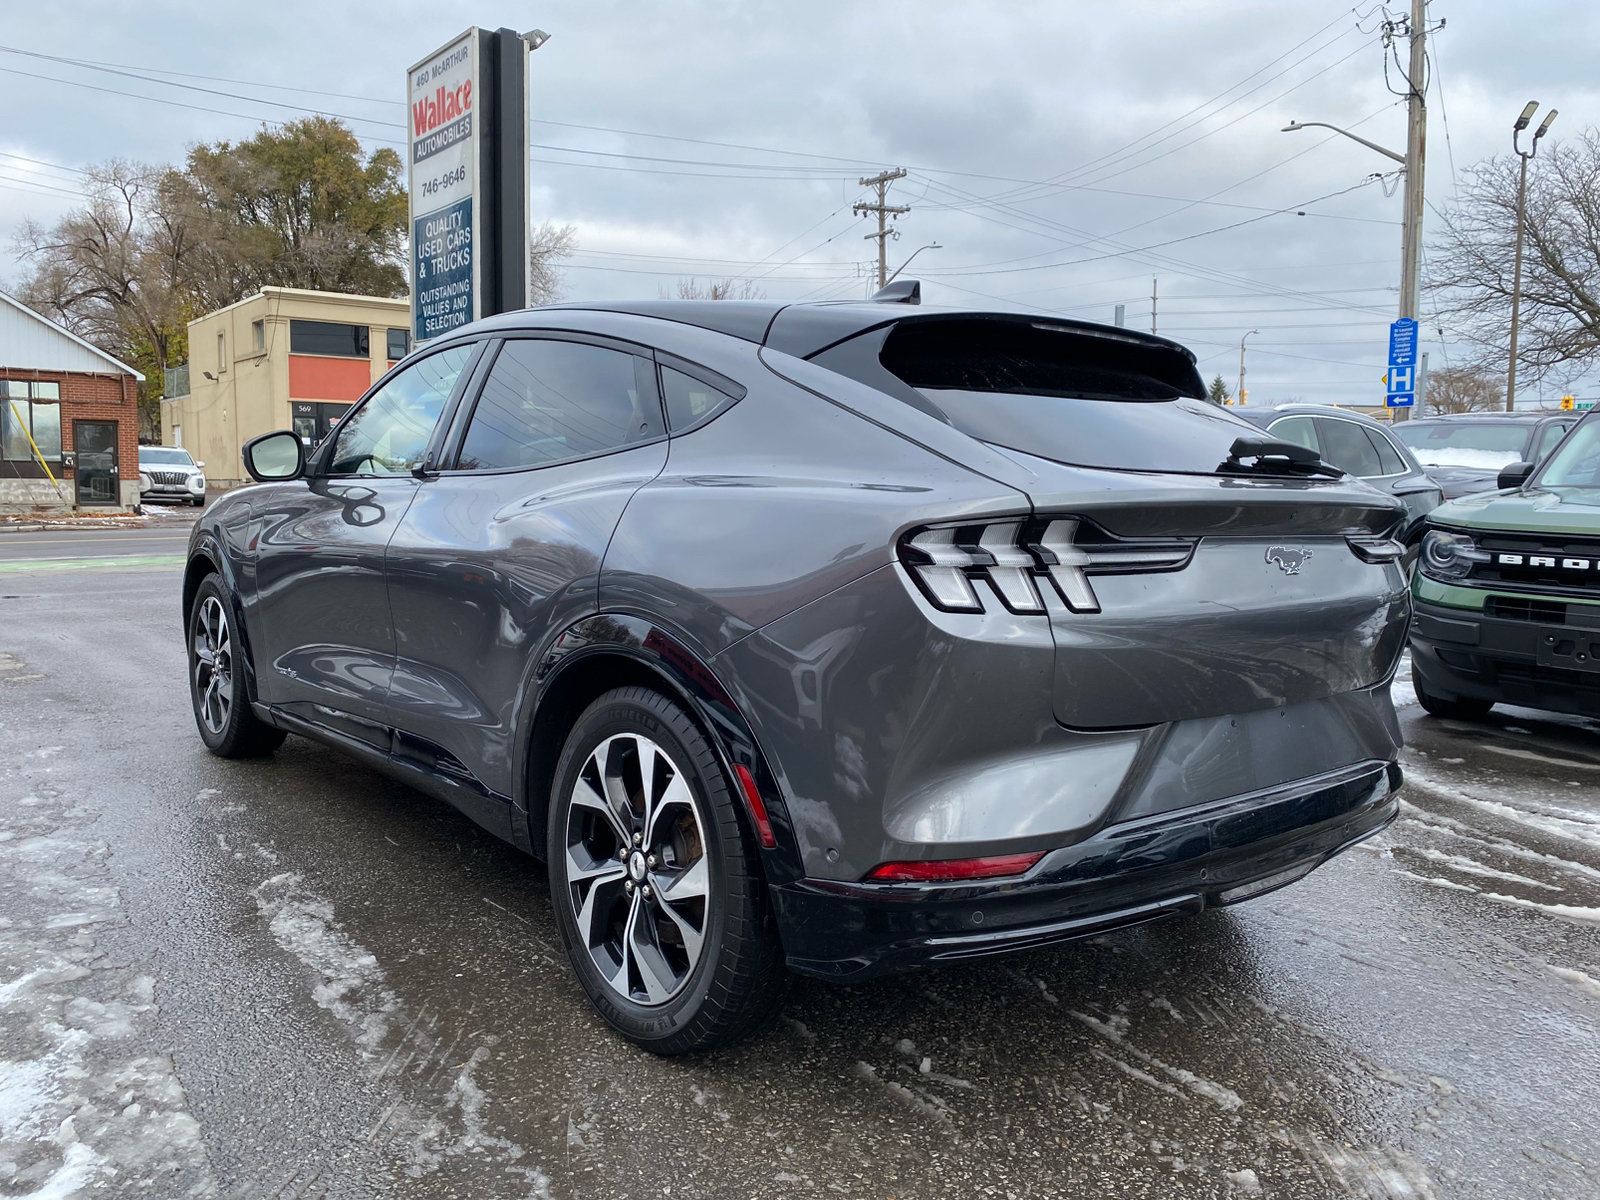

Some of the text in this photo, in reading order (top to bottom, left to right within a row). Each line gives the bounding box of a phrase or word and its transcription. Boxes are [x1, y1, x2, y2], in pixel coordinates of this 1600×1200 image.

[416, 45, 468, 87] 460 McARTHUR
[412, 79, 472, 137] Wallace
[416, 117, 470, 158] AUTOMOBILES
[422, 165, 465, 197] 746-9646
[425, 210, 463, 238] QUALITY
[418, 227, 471, 259] USED CARS
[419, 248, 470, 279] & TRUCKS
[420, 278, 470, 304] OUTSTANDING
[422, 294, 468, 318] VALUES AND
[425, 310, 465, 332] SELECTION
[1391, 368, 1411, 391] H
[298, 405, 312, 413] 569
[1498, 554, 1600, 570] BRO
